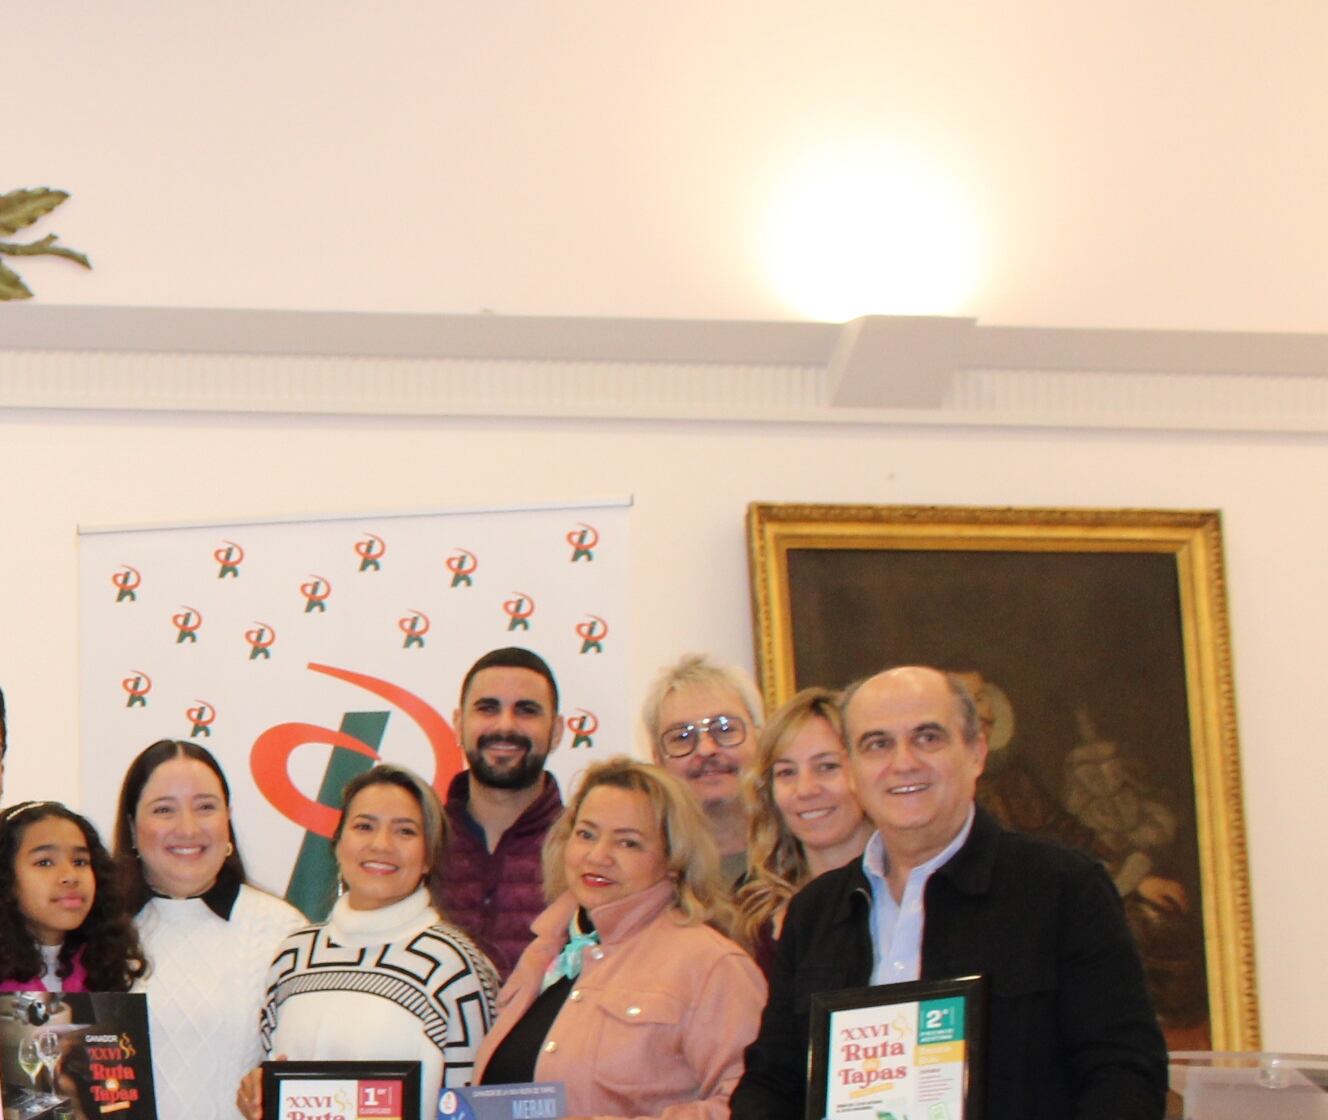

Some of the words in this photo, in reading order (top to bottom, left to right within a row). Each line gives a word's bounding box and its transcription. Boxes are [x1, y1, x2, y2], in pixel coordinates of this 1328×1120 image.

[841, 1023, 889, 1041] XXVI
[841, 1041, 905, 1062] Ruta
[90, 1063, 135, 1080] Ruta
[838, 1065, 907, 1089] Tapas
[90, 1086, 139, 1104] Tapas
[286, 1096, 332, 1108] XXVI
[512, 1099, 556, 1119] MERAKI
